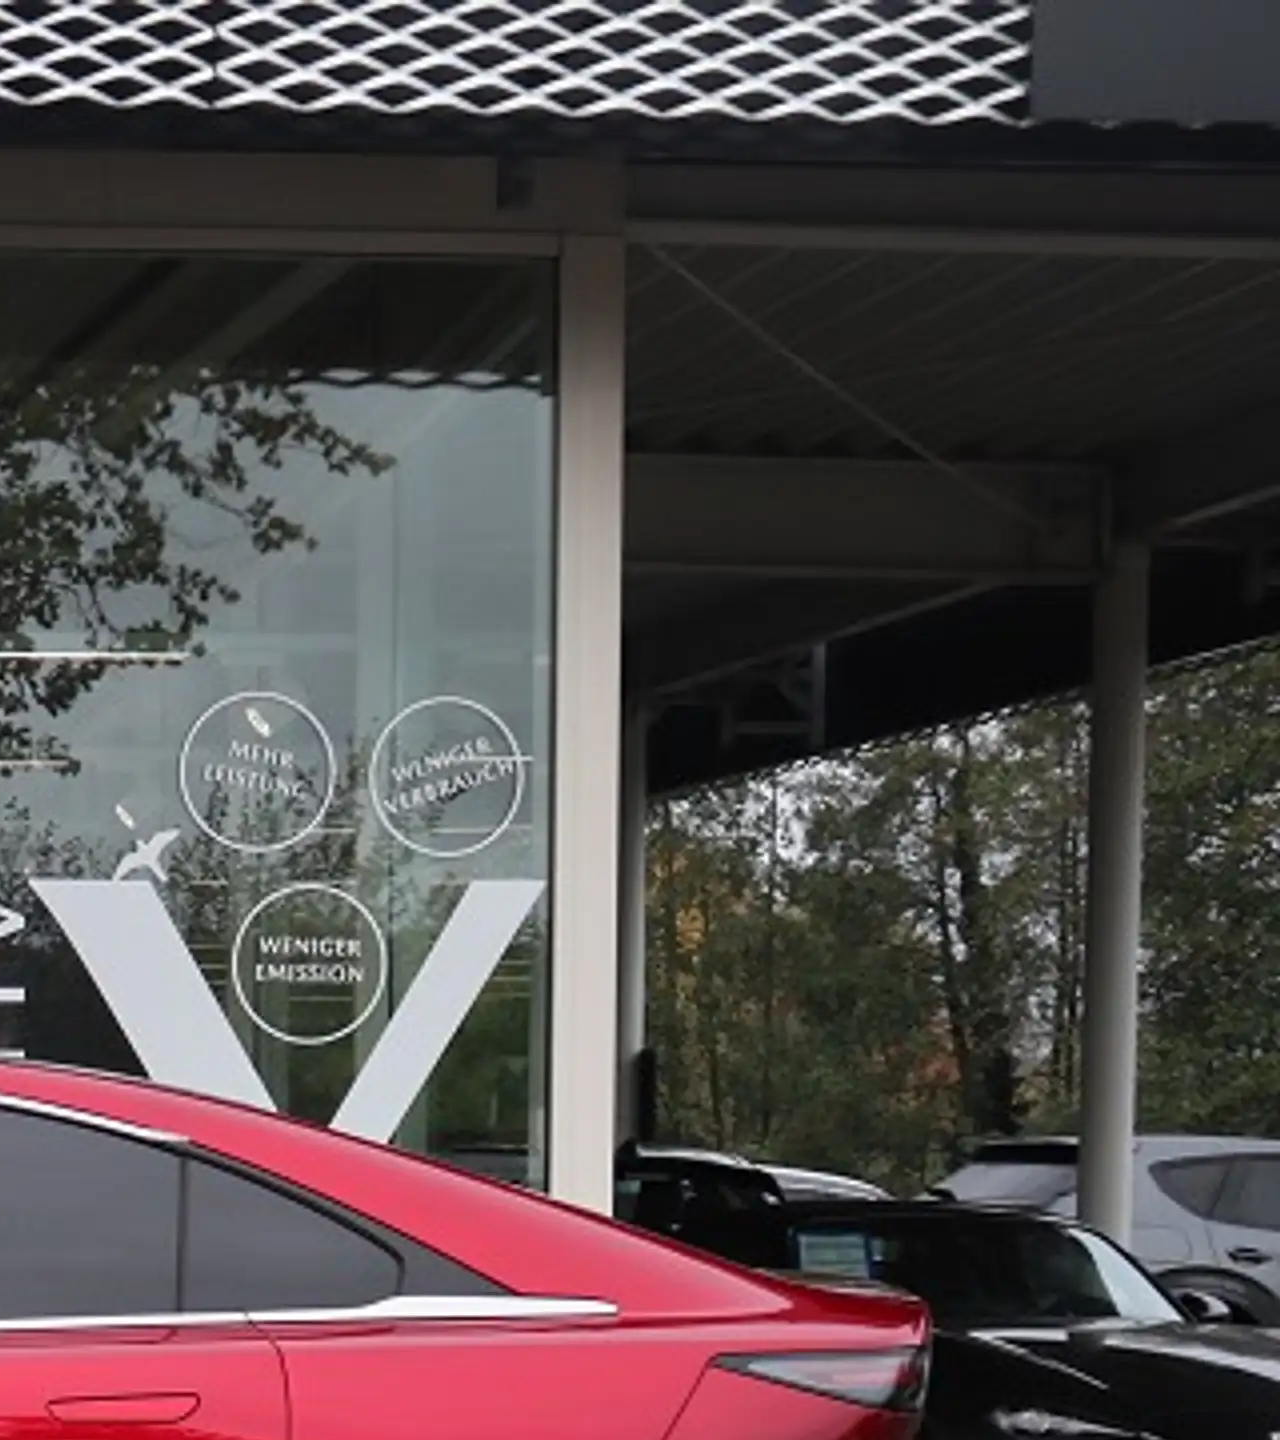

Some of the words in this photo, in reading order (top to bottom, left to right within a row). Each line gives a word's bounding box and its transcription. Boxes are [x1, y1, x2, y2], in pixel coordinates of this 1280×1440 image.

[228, 740, 295, 768] MEHR
[390, 736, 493, 783] WENIGER
[203, 765, 305, 799] LEISTUNG
[384, 759, 515, 814] VERBRAUCH
[259, 935, 362, 958] WENIGER
[255, 962, 365, 984] EMISSION
